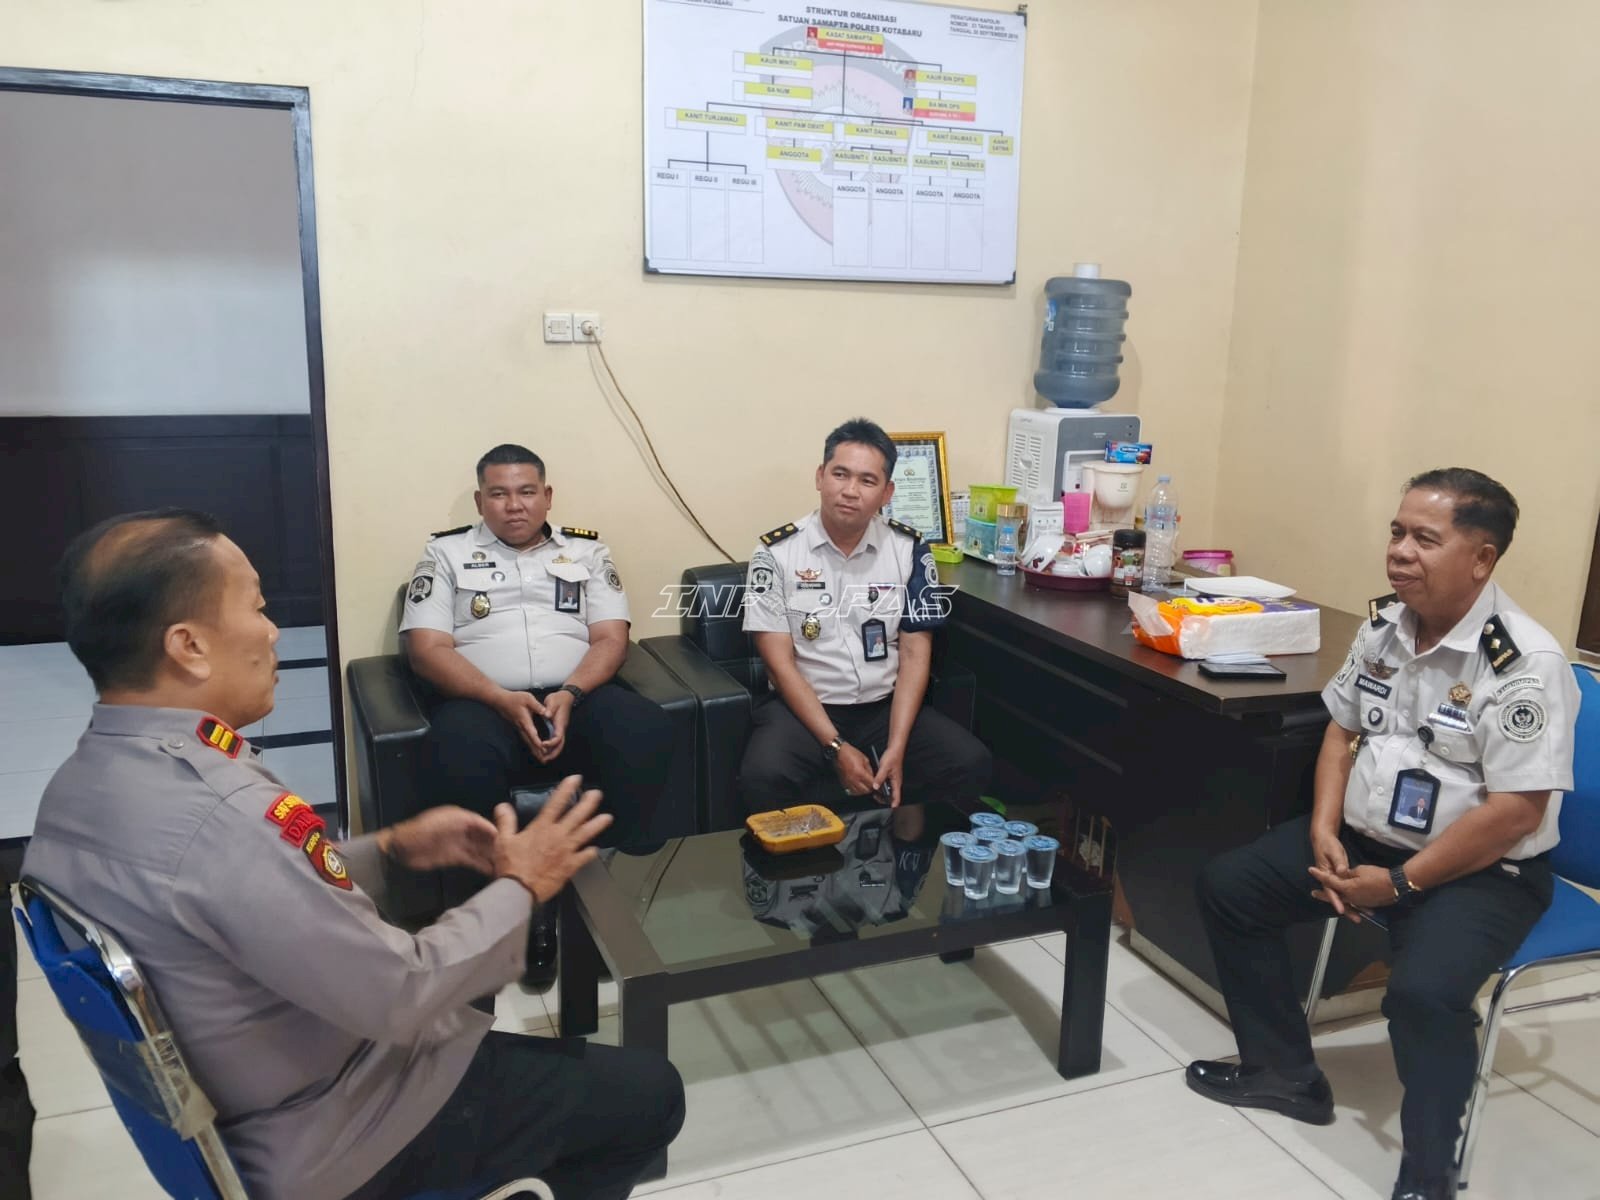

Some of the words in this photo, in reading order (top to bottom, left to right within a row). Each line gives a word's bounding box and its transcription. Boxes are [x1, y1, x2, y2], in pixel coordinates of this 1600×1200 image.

[806, 6, 848, 18] STRUKTUR
[850, 11, 897, 23] ORGANISASI
[778, 14, 810, 25] SATUAN
[811, 18, 848, 29] SAMAPTA
[850, 23, 880, 33] POLRES
[882, 26, 923, 37] KOTABARU
[846, 33, 873, 41] SAMAPTA
[779, 150, 809, 158] ANGGOTA
[656, 172, 675, 180] REGU
[695, 175, 713, 183] REGU
[732, 178, 750, 186] REGU
[837, 185, 866, 193] ANGGOTA
[916, 189, 944, 198] ANGGOTA
[953, 191, 980, 200] ANGGOTA
[1358, 676, 1388, 695] MAWARDI
